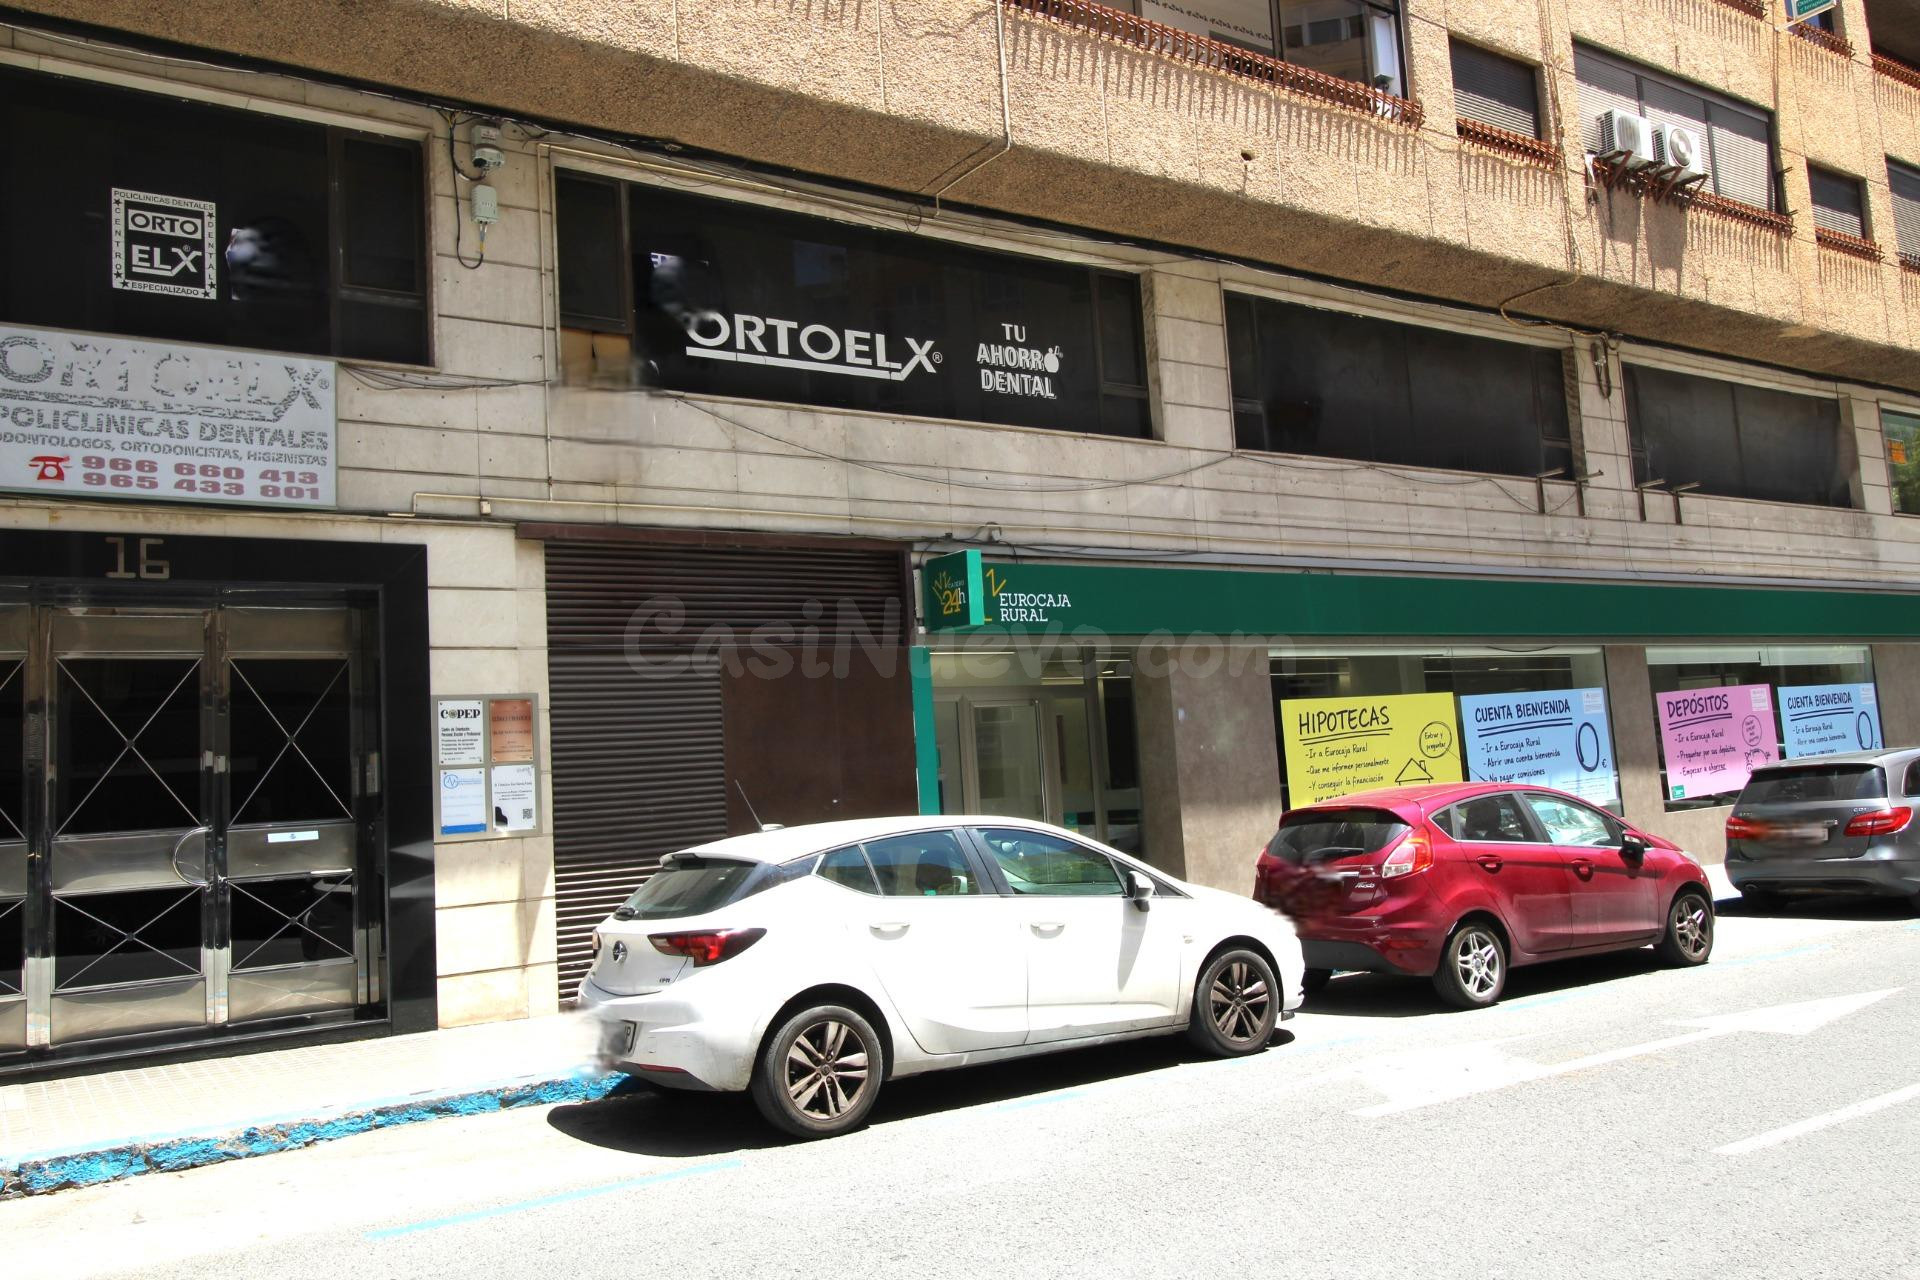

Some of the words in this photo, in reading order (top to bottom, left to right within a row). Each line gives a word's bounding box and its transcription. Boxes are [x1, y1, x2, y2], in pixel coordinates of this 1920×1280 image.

[114, 190, 171, 205] POLICLINICAS
[172, 199, 215, 211] DENTALES
[130, 212, 199, 235] ORTO
[114, 207, 122, 271] CENTRO
[131, 281, 199, 296] ESPECIALIZADO
[1001, 323, 1026, 342] TU
[981, 369, 1057, 399] DENTAL
[0, 432, 115, 451] DONTOLOGOS,
[199, 422, 329, 451] DENTALES
[82, 456, 159, 473] 966
[174, 463, 245, 480] 660
[259, 469, 319, 485] 413
[83, 472, 159, 489] 965
[174, 479, 245, 496] 433
[260, 485, 320, 500] 801
[105, 537, 170, 579] 16
[942, 588, 967, 615] 24h
[999, 593, 1072, 608] EUROCAJA
[1000, 608, 1049, 622] RURAL
[1667, 693, 1729, 718] DEPÓSITOS
[1787, 695, 1813, 710] CUENTA
[1815, 692, 1852, 707] BIENVENIDA
[1299, 706, 1390, 735] HIPOTECAS
[1475, 704, 1513, 723] CUENTA
[1515, 699, 1571, 719] BIENVENIDA
[1711, 728, 1724, 738] Rural
[1325, 747, 1351, 758] Eurocaja
[1353, 742, 1368, 753] Rural
[1500, 741, 1524, 753] Eurocaja
[1525, 736, 1541, 747] Rural
[1355, 757, 1390, 772] personalmente
[1504, 757, 1514, 765] una
[1516, 753, 1533, 763] cuenta
[1535, 749, 1561, 761] bienvenida
[1517, 768, 1546, 779] comisiones
[1318, 780, 1343, 791] conseguir
[1345, 776, 1351, 785] la
